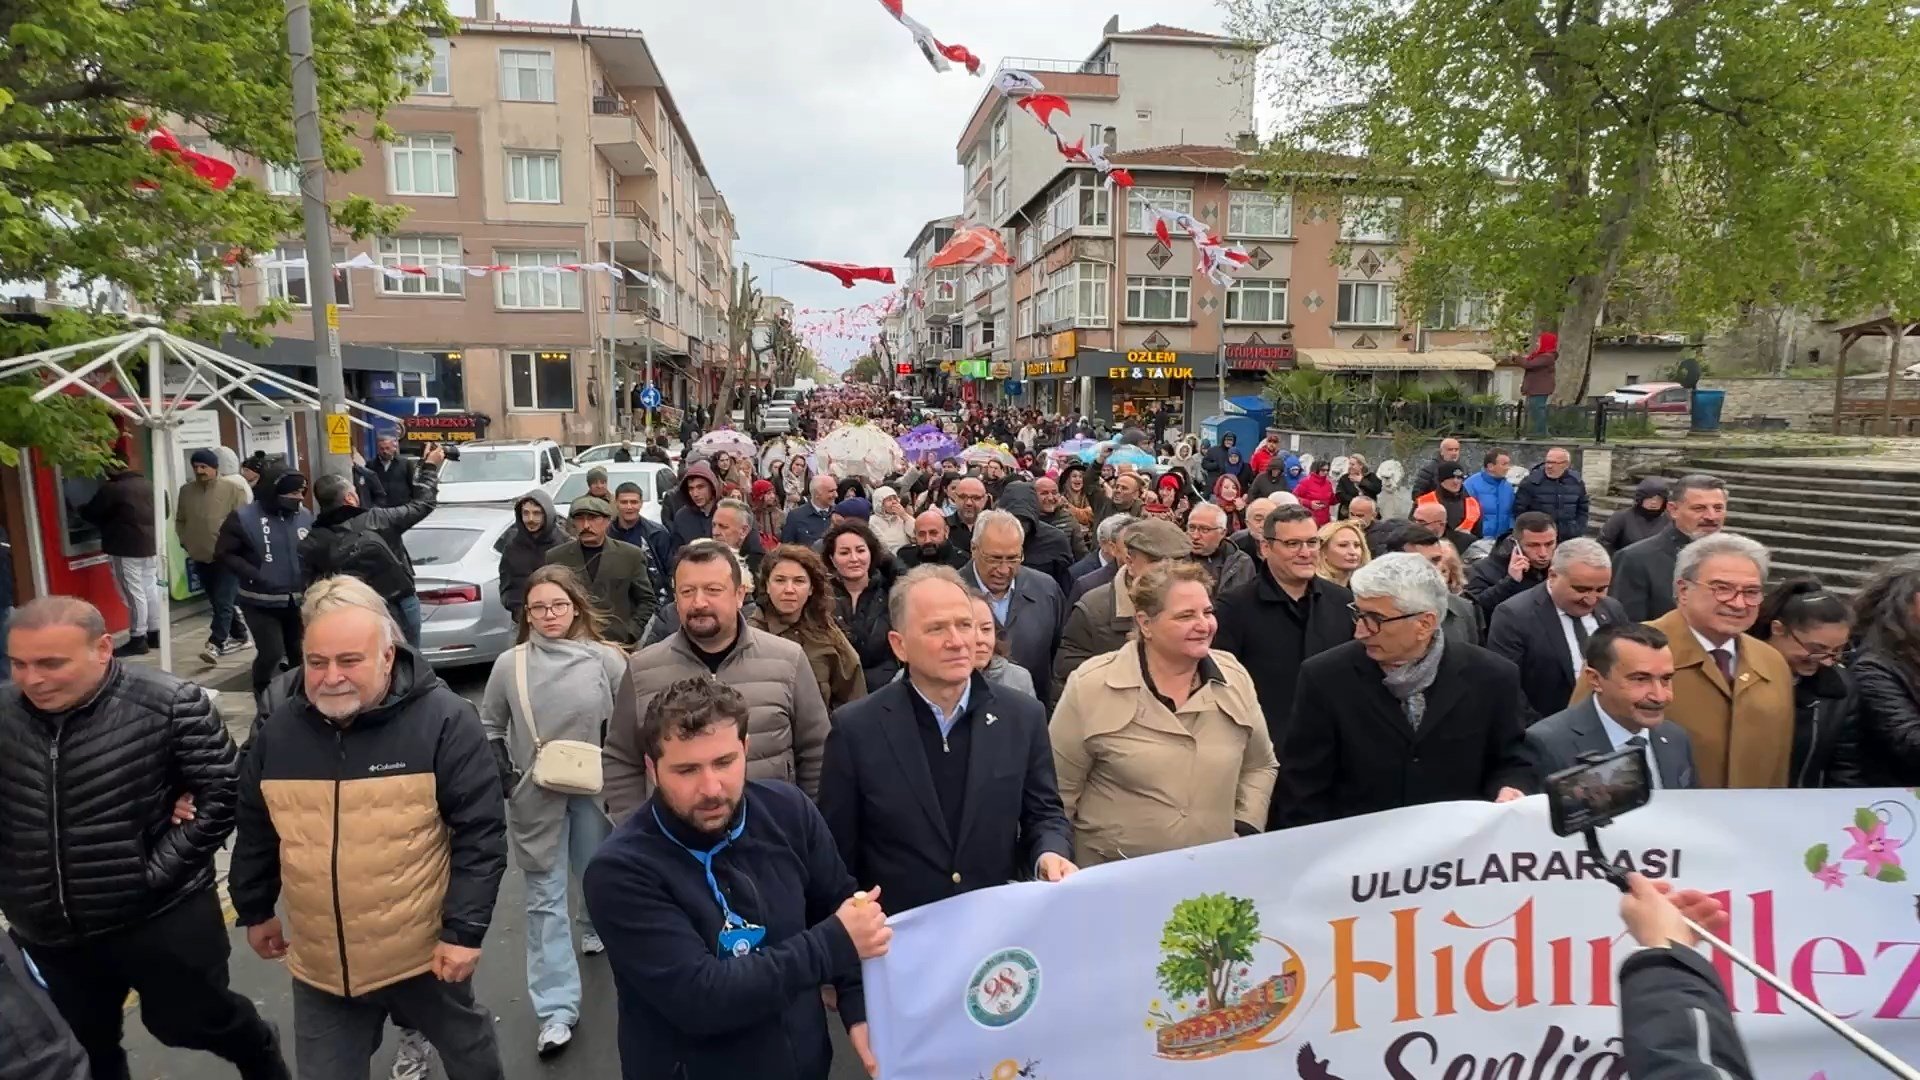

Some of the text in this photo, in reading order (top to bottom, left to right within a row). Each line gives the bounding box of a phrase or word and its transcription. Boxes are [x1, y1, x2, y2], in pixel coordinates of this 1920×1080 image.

[1109, 366, 1193, 379] ET & TAVUK
[376, 762, 406, 771] Columbia
[1351, 848, 1682, 902] ULUSLARARASI
